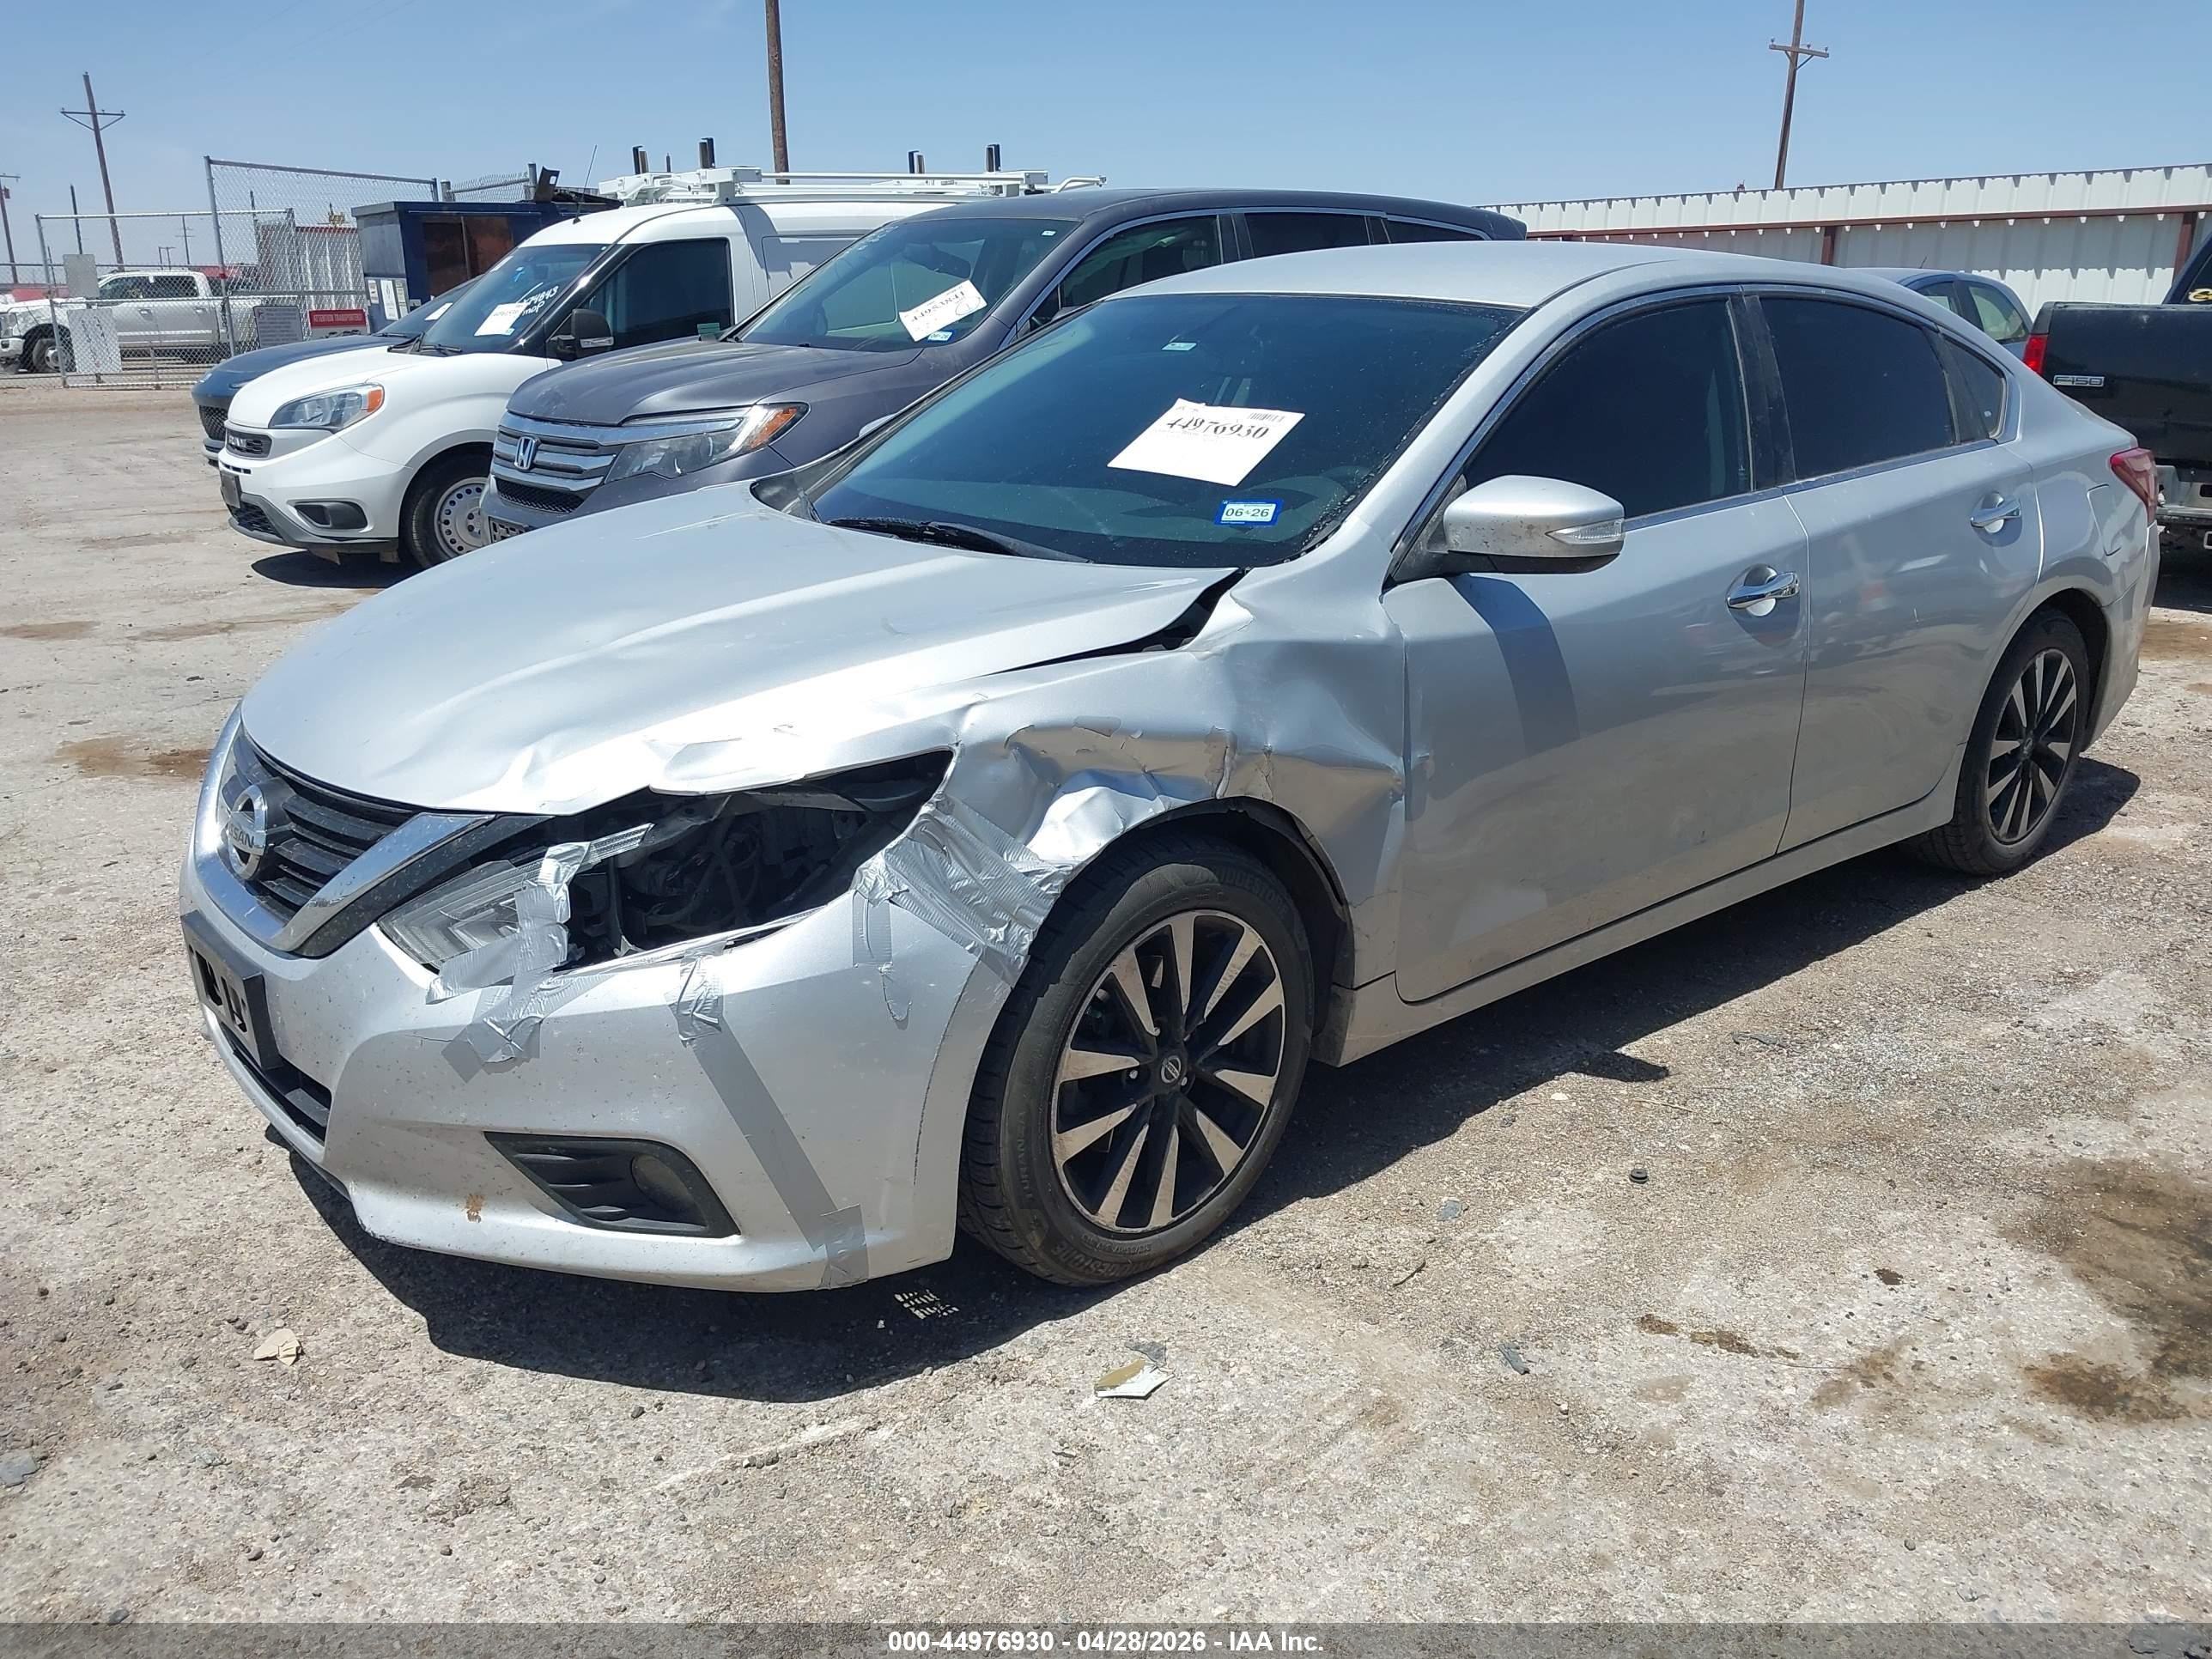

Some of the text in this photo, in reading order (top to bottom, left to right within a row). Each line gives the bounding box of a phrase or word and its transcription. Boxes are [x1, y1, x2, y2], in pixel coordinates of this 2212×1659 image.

[1166, 416, 1269, 440] 44976930
[1225, 507, 1270, 518] 06 26
